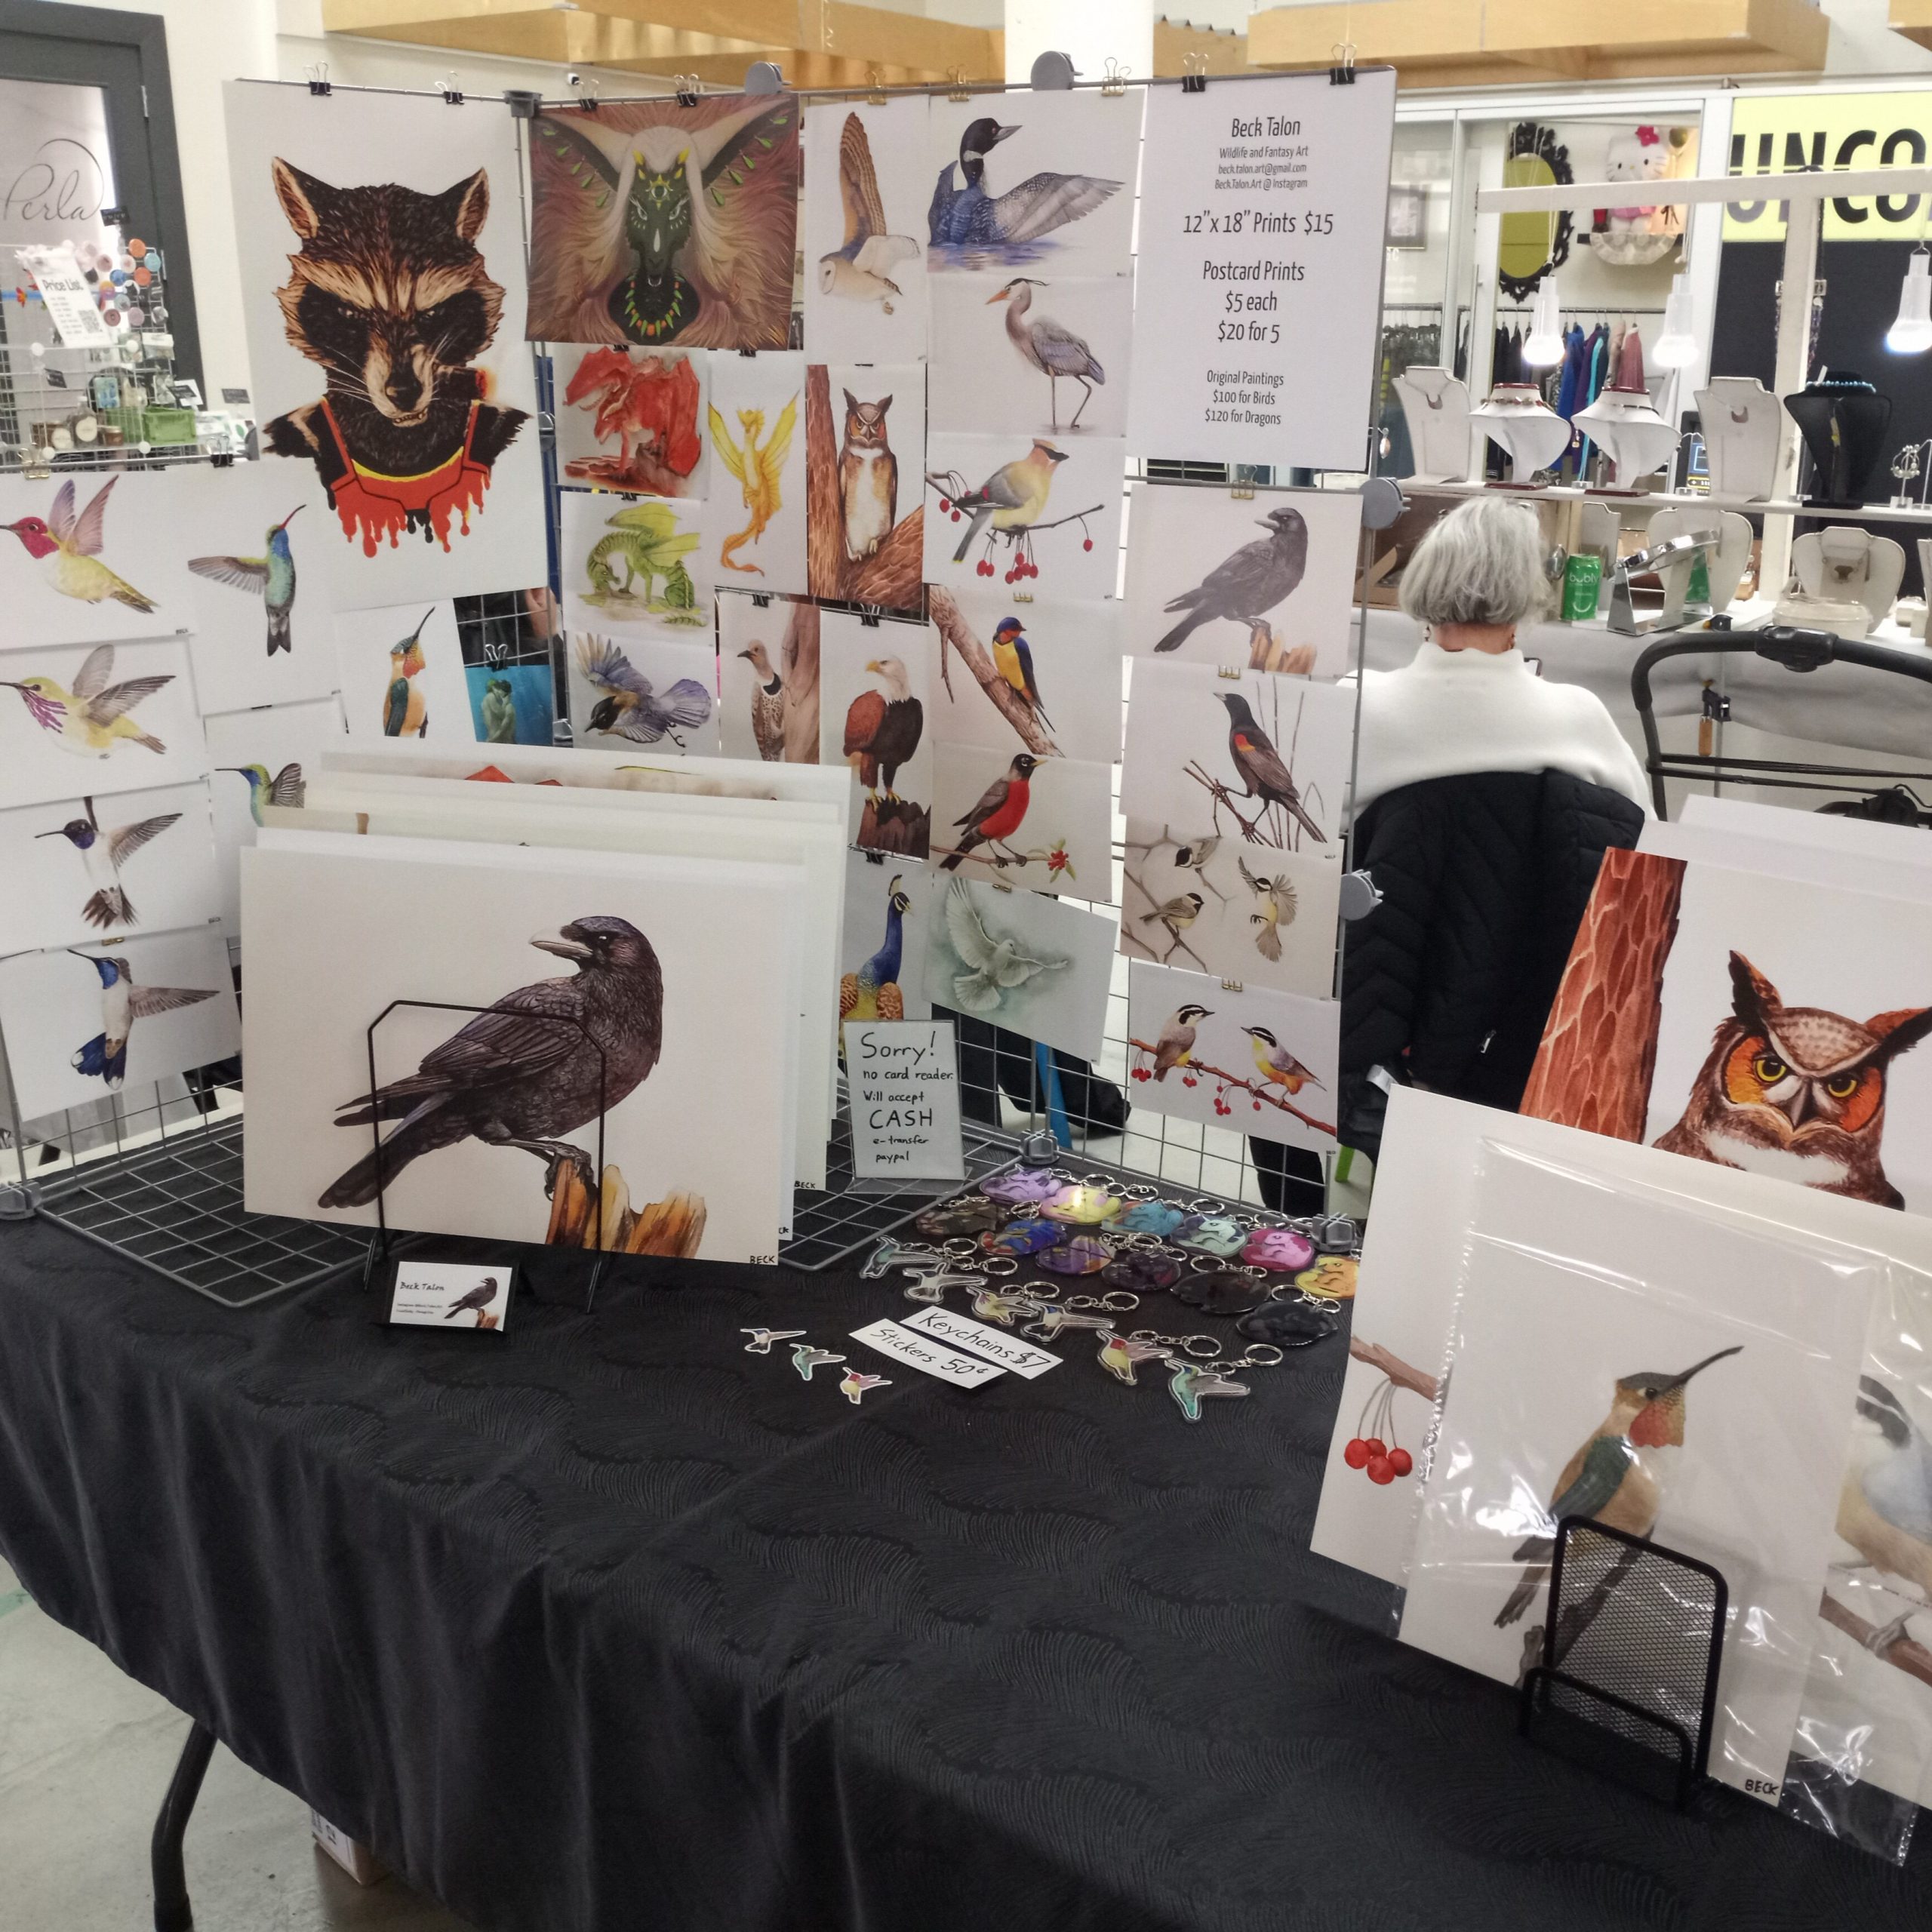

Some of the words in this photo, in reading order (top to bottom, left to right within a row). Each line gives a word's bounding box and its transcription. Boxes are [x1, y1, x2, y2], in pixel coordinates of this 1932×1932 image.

[1232, 117, 1262, 137] Beck
[1267, 116, 1300, 136] Talon
[1220, 146, 1247, 158] Wildlife
[1249, 146, 1263, 158] and
[1265, 146, 1294, 159] Fantasy
[1296, 145, 1309, 156] Art
[1218, 162, 1306, 175] beck.talon.art@gmail.com
[1726, 128, 1932, 223] UNCO
[0, 138, 104, 220] Perla
[1263, 179, 1272, 190] @
[1273, 179, 1308, 190] Instagram
[1254, 211, 1296, 233] Prints
[1304, 211, 1334, 235] $15
[1203, 261, 1260, 281] Postcard
[1264, 261, 1305, 281] Prints
[42, 279, 66, 291] Price
[1225, 291, 1243, 312] $5
[1246, 291, 1277, 311] each
[1218, 321, 1244, 343] $20
[1248, 321, 1267, 341] for
[1270, 325, 1280, 344] 5
[1207, 370, 1241, 386] Original
[1242, 371, 1284, 387] Paintings
[1213, 389, 1236, 405] $100
[1238, 391, 1251, 404] for
[1253, 391, 1275, 405] Birds
[1205, 408, 1229, 423] $120
[1231, 409, 1243, 423] for
[1245, 411, 1281, 426] Dragons
[861, 1031, 937, 1066] Sorry!
[863, 1069, 878, 1079] no
[884, 1066, 909, 1079] card
[863, 1090, 883, 1102] Will
[888, 1091, 924, 1105] accept
[869, 1108, 933, 1129] CASH
[873, 1134, 929, 1145] e-transfer
[875, 1151, 909, 1164] paypal
[794, 1180, 816, 1189] BECK
[750, 1255, 775, 1264] BECK
[400, 1281, 420, 1291] Beck
[422, 1283, 445, 1291] Talon
[870, 1327, 937, 1363] Stickers
[918, 1312, 1016, 1360] Keychains
[1013, 1352, 1051, 1370] $7
[1745, 1779, 1780, 1795] BECK
